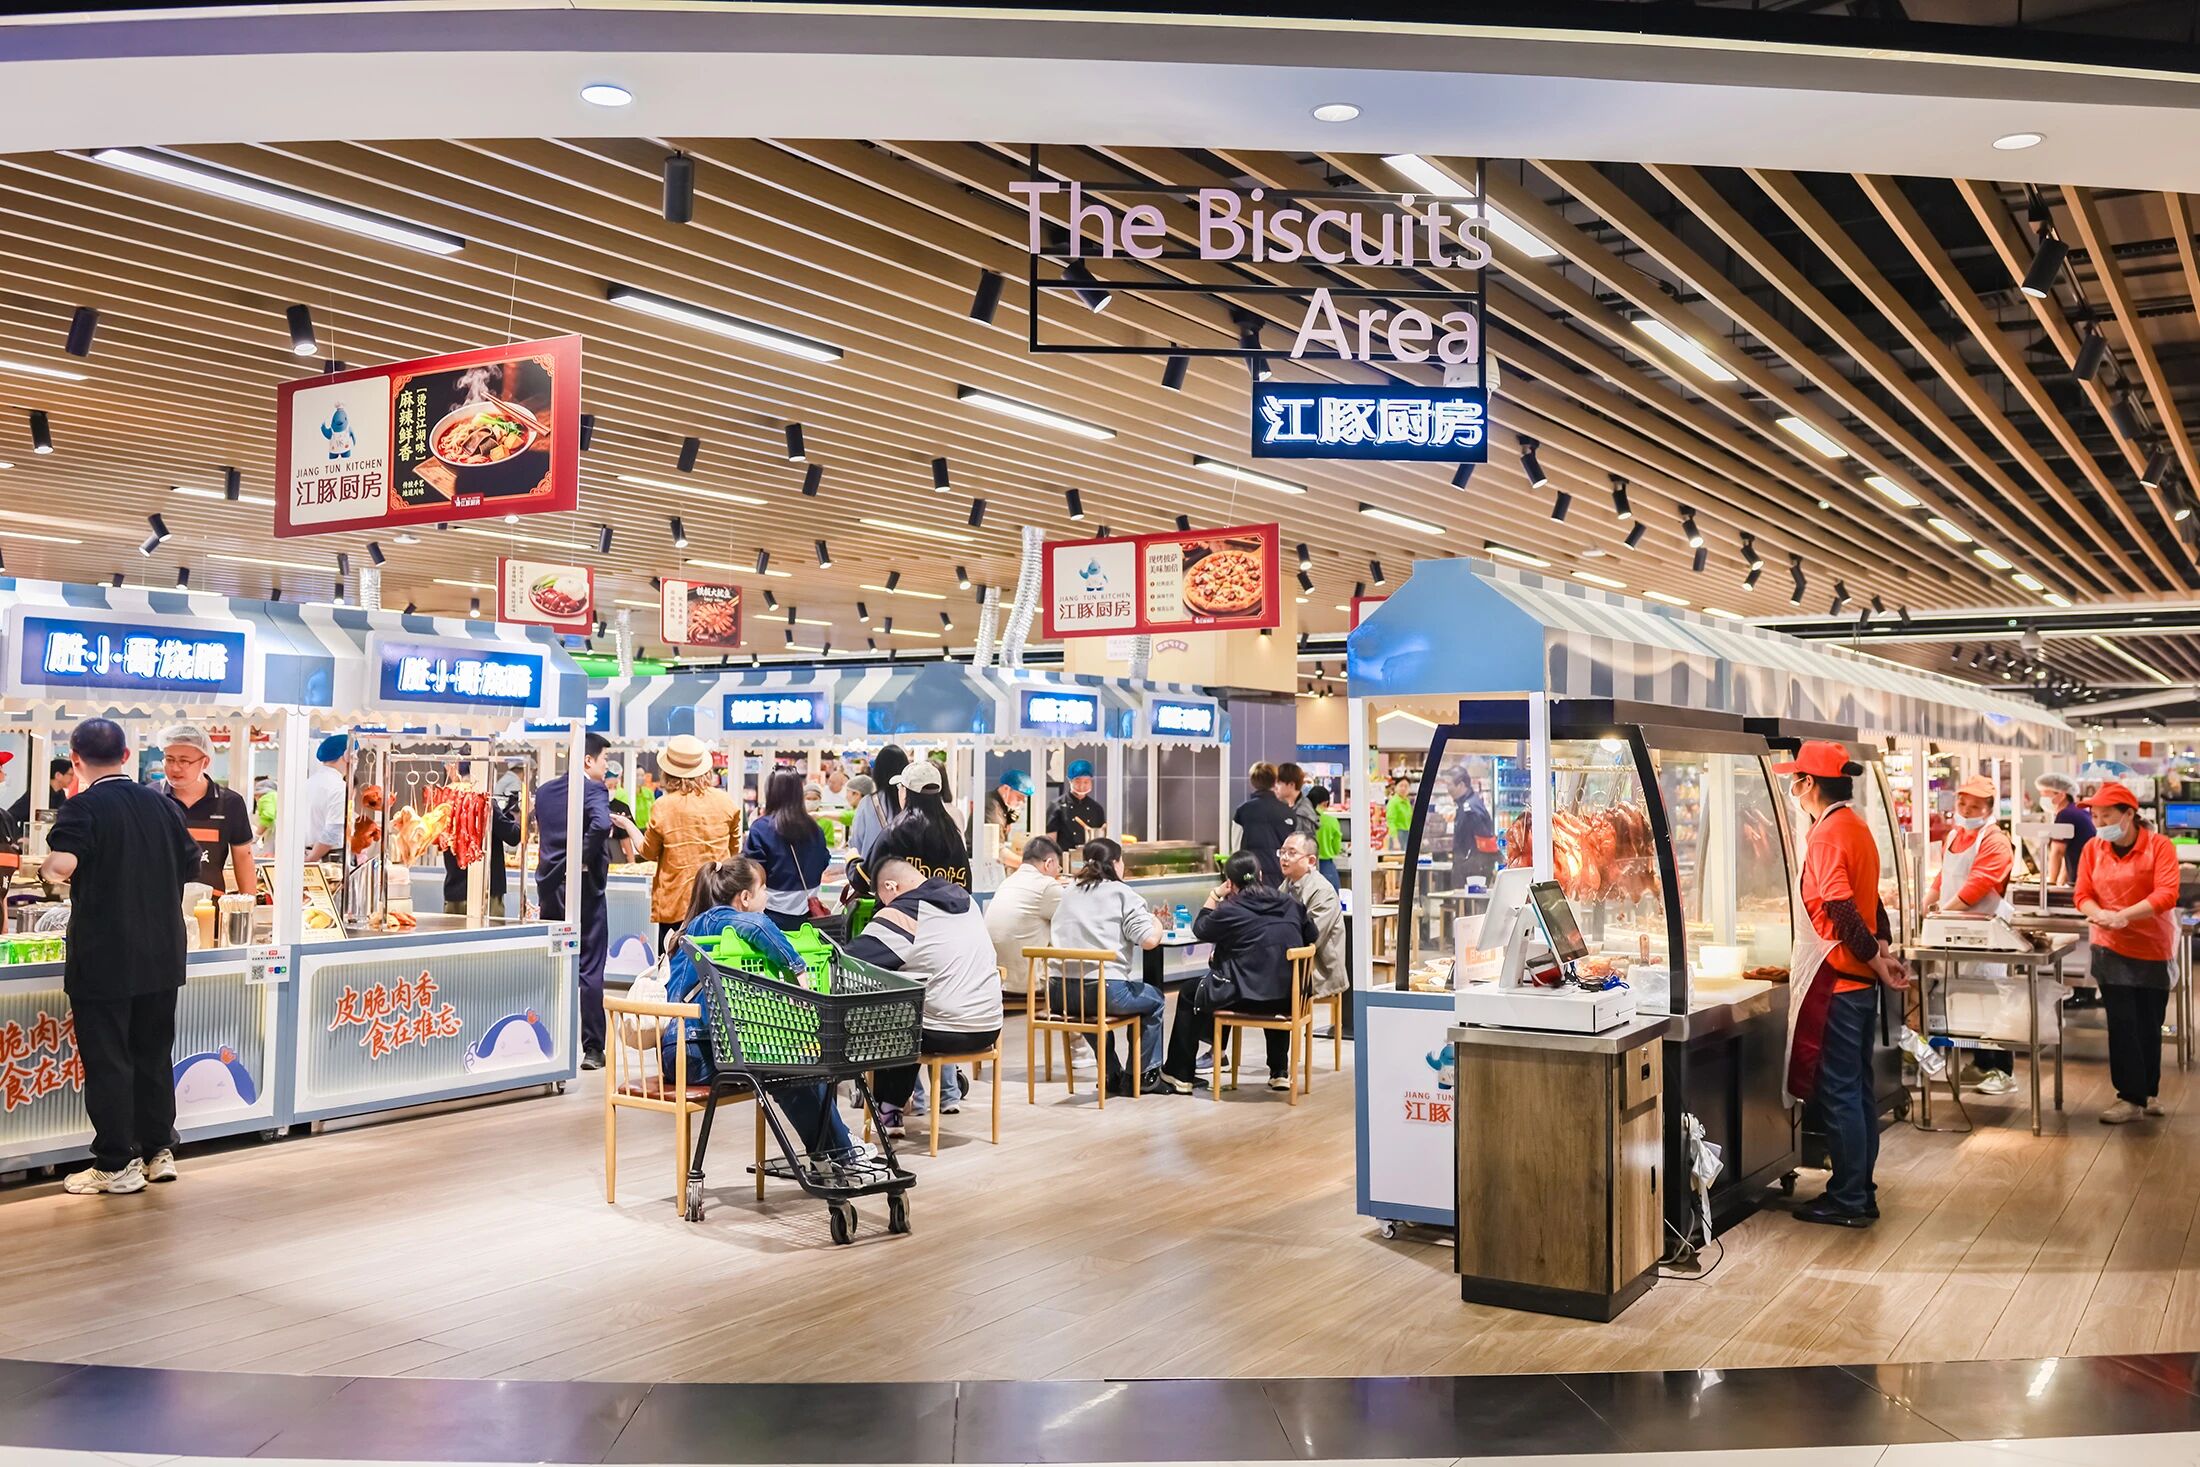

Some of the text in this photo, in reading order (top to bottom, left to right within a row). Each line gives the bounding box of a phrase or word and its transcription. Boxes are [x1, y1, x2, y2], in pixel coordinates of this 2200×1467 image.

[1009, 181, 1492, 269] The Biscuits
[1291, 288, 1479, 364] Area
[398, 390, 414, 461] 麻辣鲜香
[1262, 395, 1484, 446] 江豚厨房
[296, 459, 382, 478] JIANG TUN KITCHEN
[296, 471, 382, 506] 江豚厨房
[1059, 600, 1131, 620] 江豚厨房
[329, 970, 438, 1030] 皮脆肉香
[360, 1003, 462, 1059] 食在难忘
[1404, 1091, 1454, 1101] JIANG TUN
[1405, 1100, 1452, 1123] 江豚
